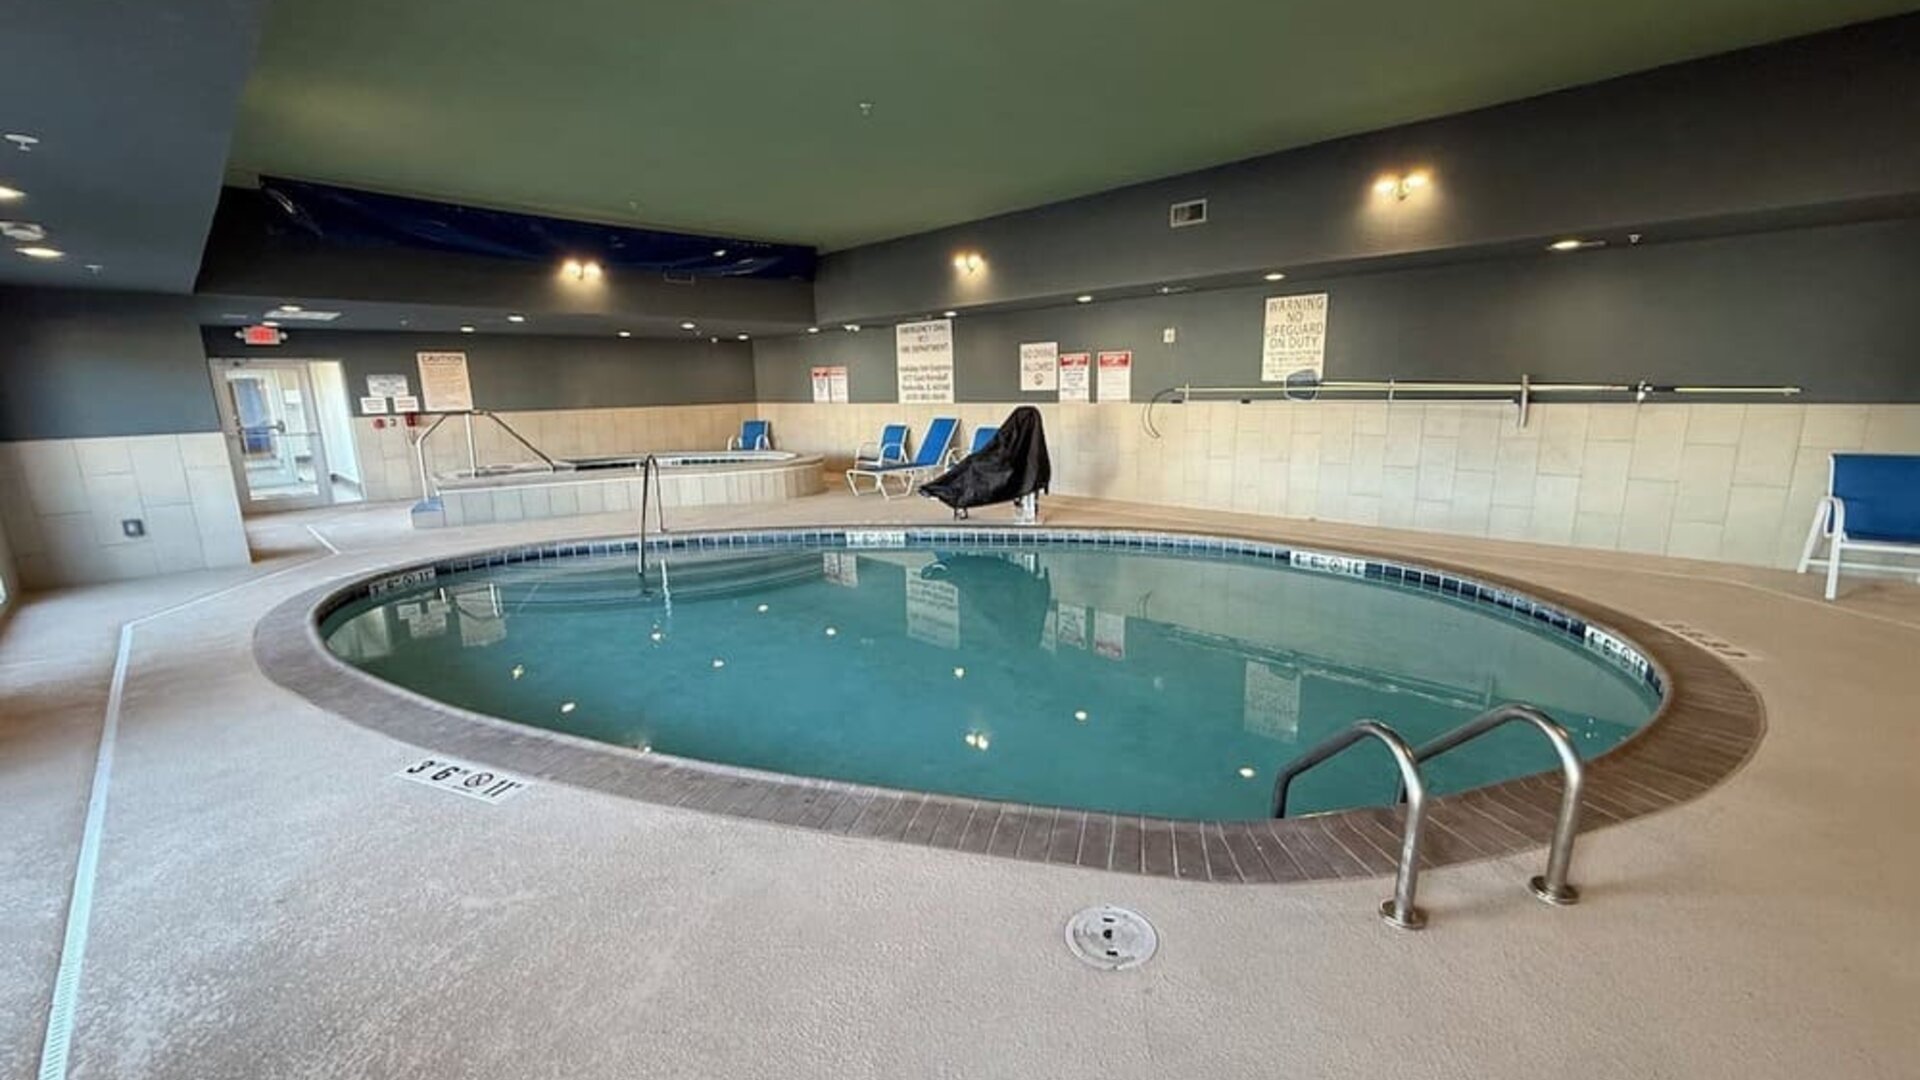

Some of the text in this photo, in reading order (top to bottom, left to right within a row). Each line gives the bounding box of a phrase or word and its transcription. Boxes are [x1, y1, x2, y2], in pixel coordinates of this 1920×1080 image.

[1269, 297, 1324, 312] WARNING
[1286, 311, 1304, 323] NO
[1267, 323, 1323, 336] LIFEGUARD
[1269, 336, 1319, 349] ON DUTY
